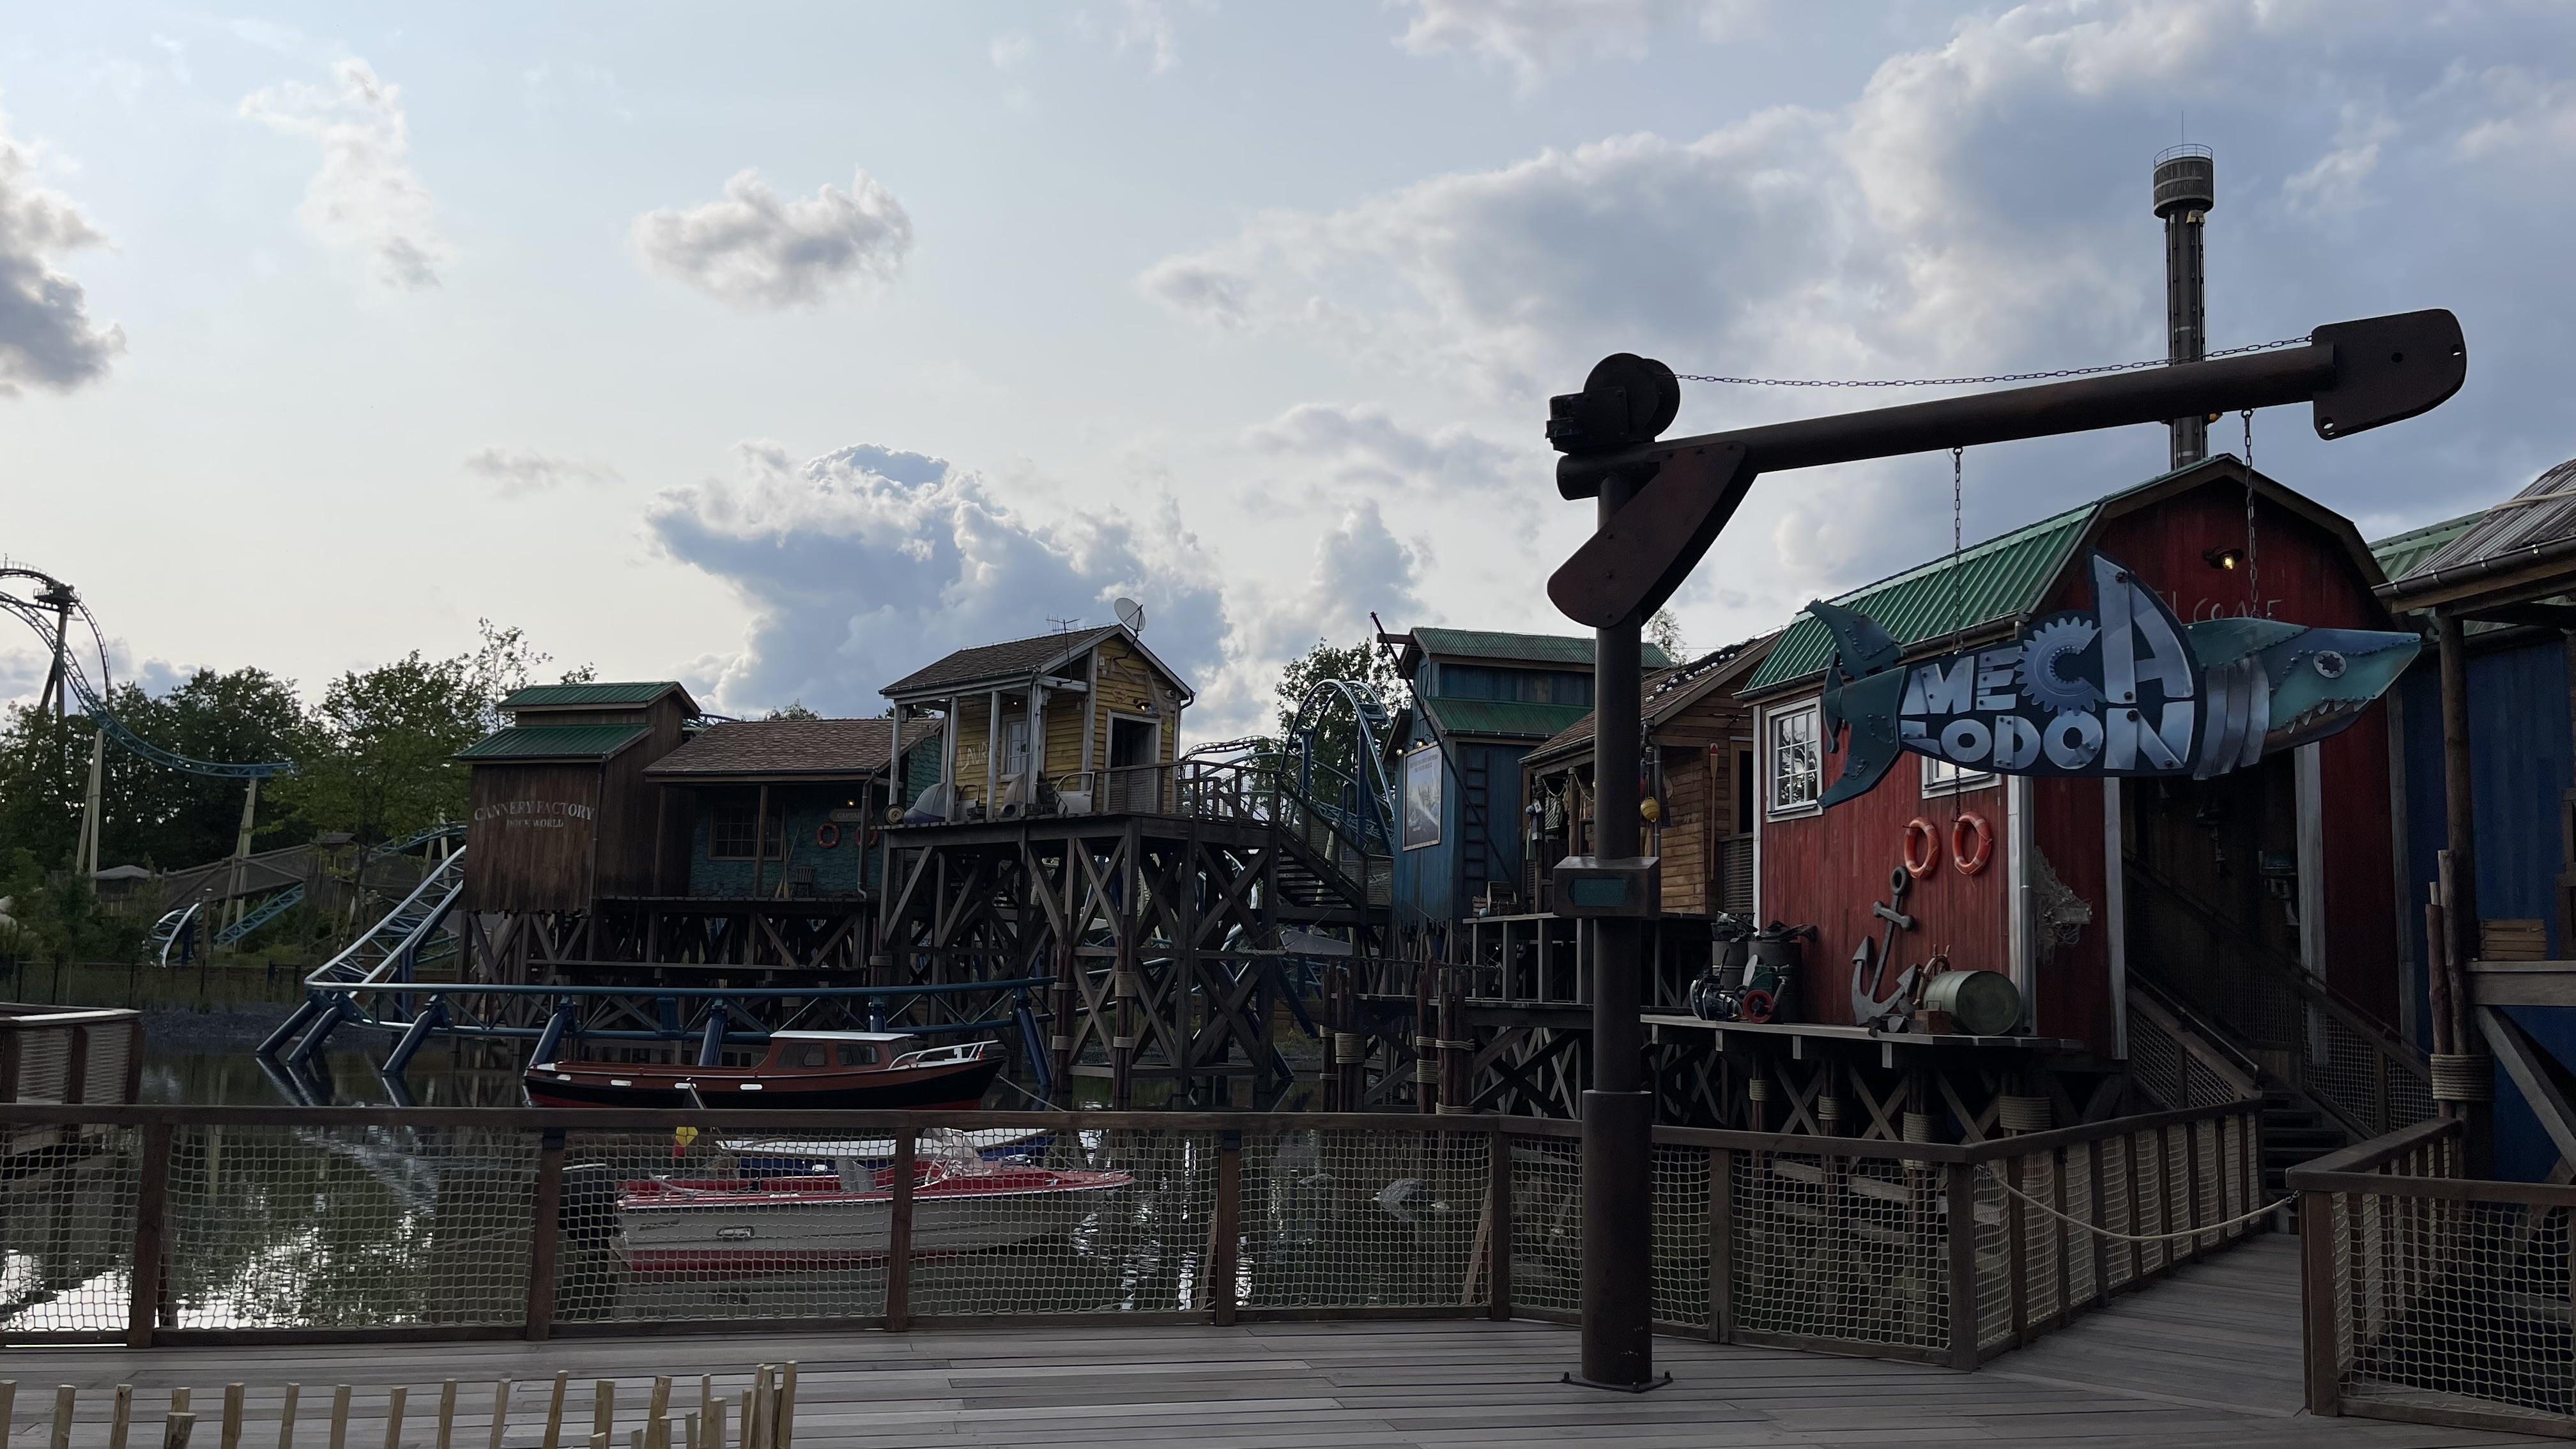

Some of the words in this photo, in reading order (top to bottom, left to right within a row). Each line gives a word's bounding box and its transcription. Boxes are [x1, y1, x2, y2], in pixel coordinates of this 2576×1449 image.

[474, 801, 534, 820] CANNERY
[536, 801, 595, 820] FACTORY
[507, 819, 531, 828] DOCK
[533, 818, 564, 828] WORLD
